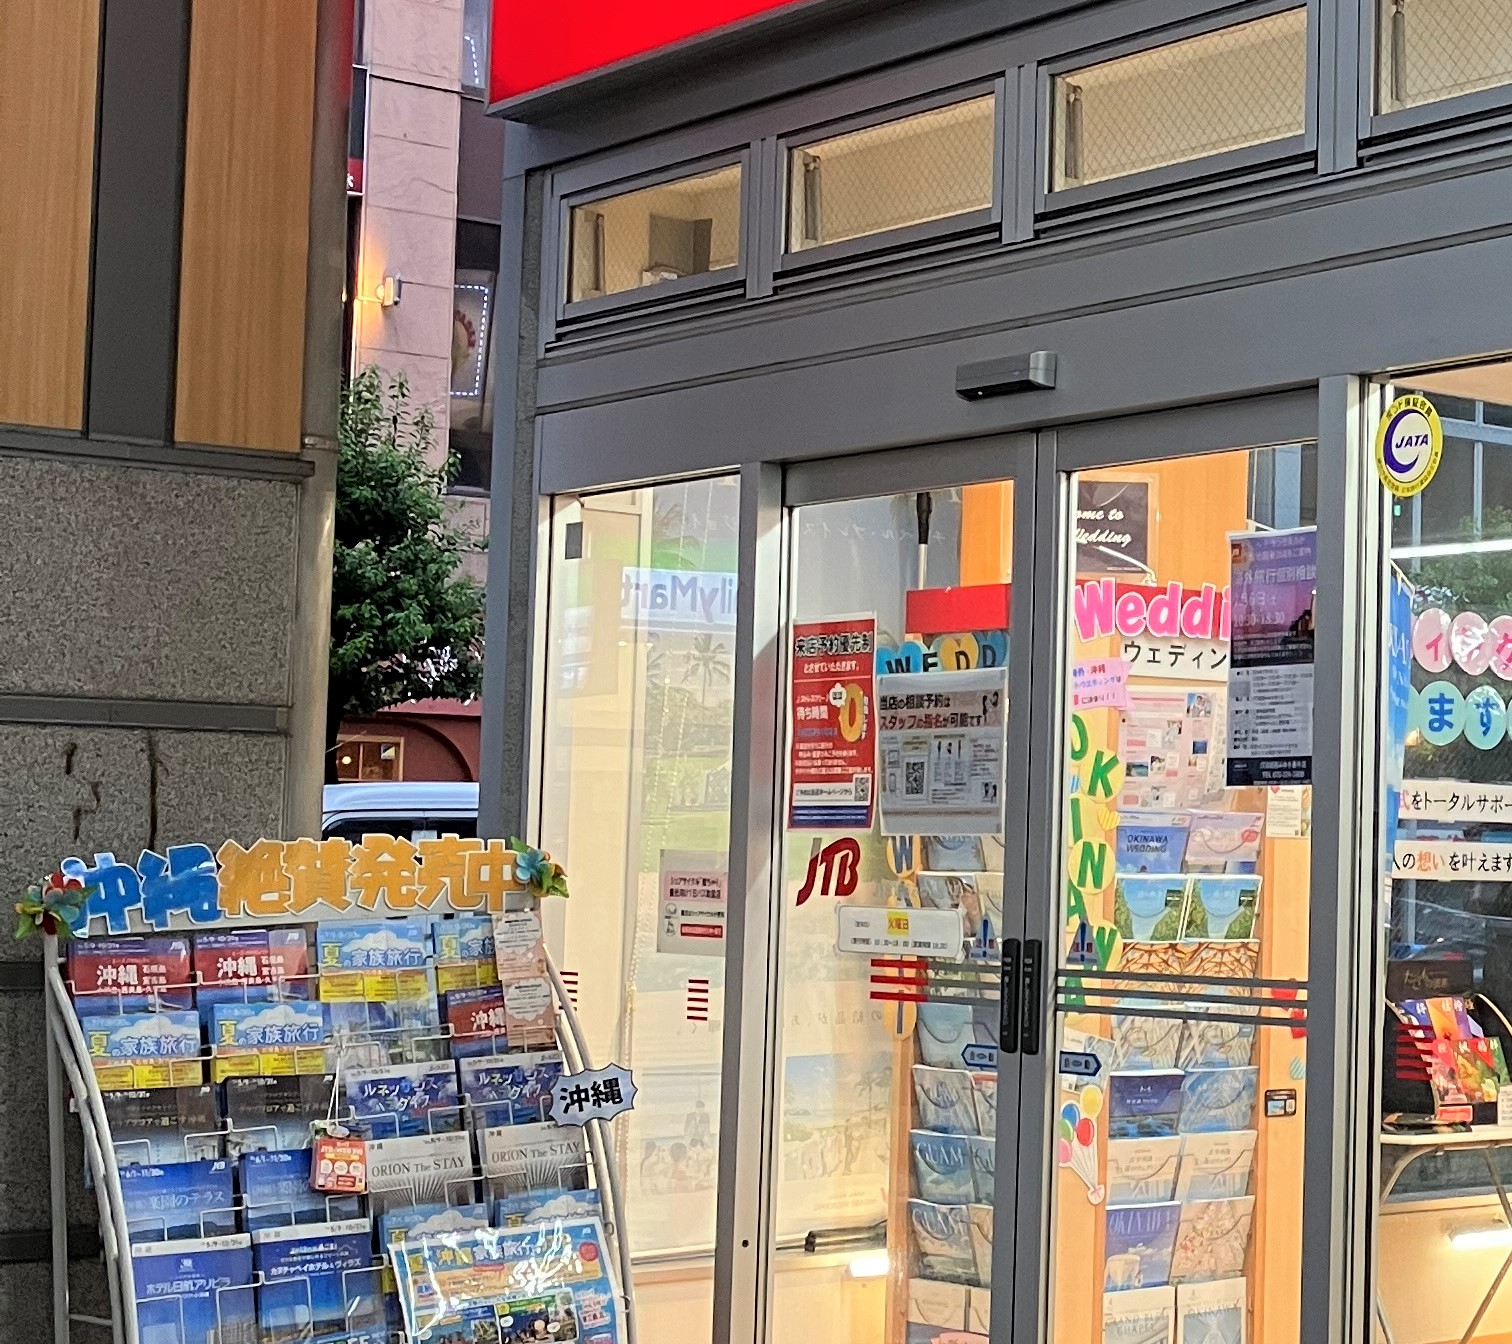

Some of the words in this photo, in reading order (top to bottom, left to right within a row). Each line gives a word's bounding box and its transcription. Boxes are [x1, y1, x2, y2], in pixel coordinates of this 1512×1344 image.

[1394, 434, 1428, 448] JATA
[796, 837, 861, 906] JTB
[96, 964, 139, 987] 沖縄
[216, 955, 258, 979] 沖縄
[560, 1077, 624, 1114] 沖縄
[490, 1148, 529, 1163] ORION
[531, 1147, 548, 1159] The
[549, 1140, 583, 1157] STAY
[916, 1143, 967, 1167] GUAM
[371, 1163, 411, 1179] ORION
[413, 1162, 431, 1174] The
[432, 1156, 467, 1172] STAY
